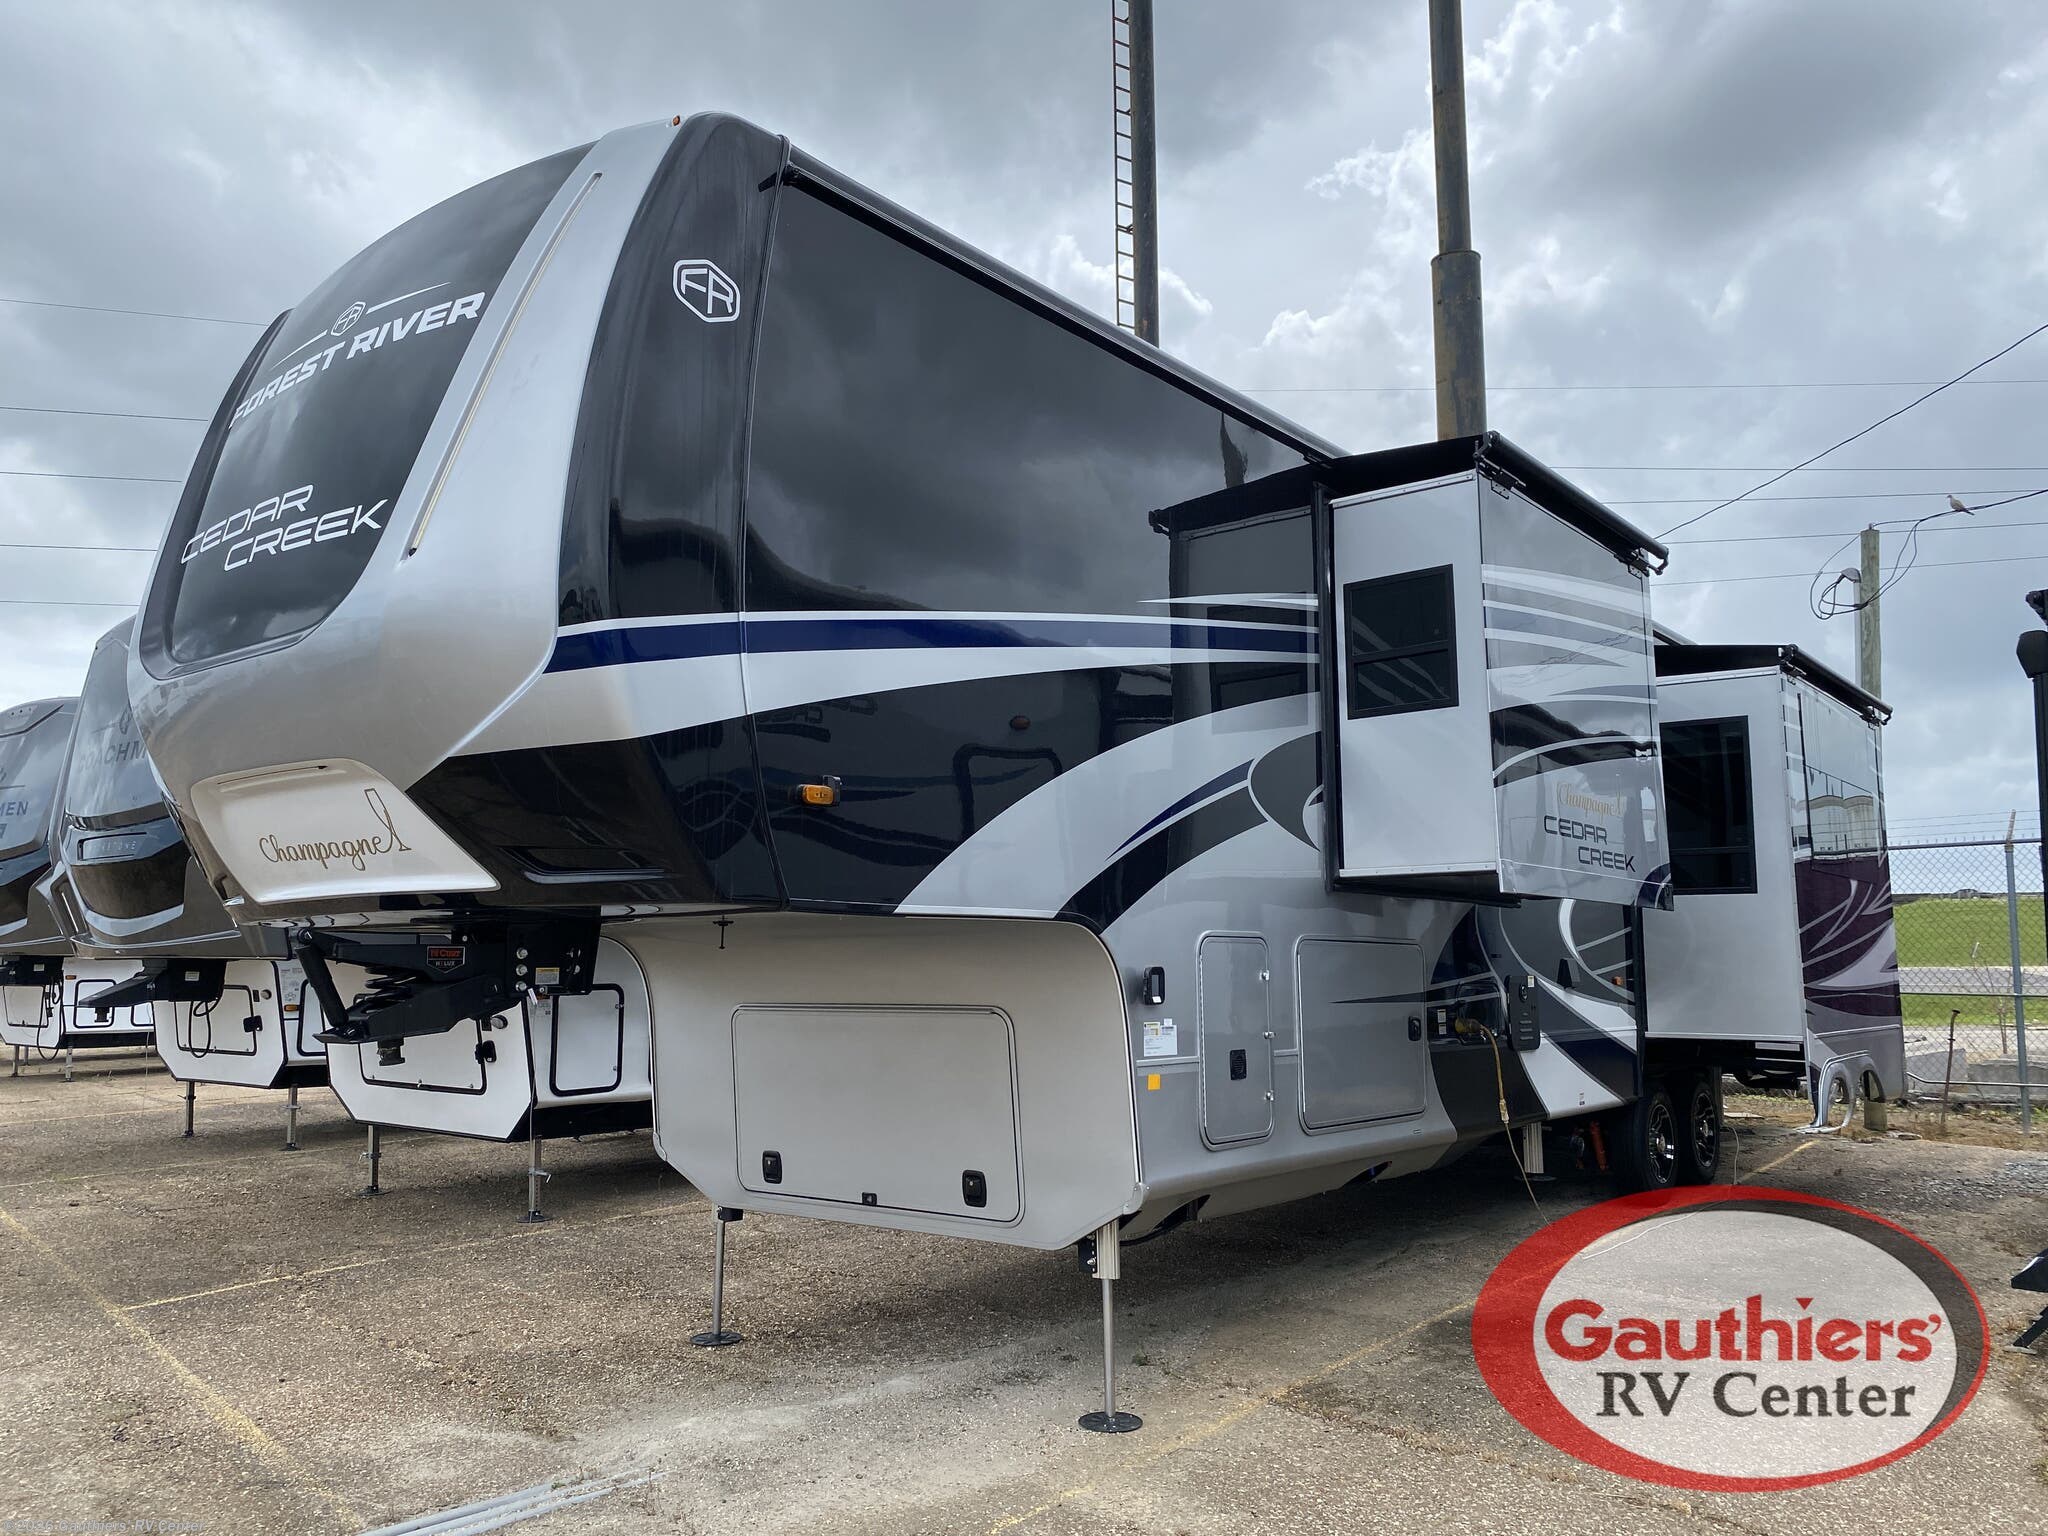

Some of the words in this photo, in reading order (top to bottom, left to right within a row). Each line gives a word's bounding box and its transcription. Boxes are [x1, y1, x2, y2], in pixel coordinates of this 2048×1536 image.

[229, 341, 346, 429] FOREST
[347, 292, 486, 359] RIVER
[181, 484, 314, 564] CEDAR
[224, 498, 389, 571] CREEK
[80, 740, 147, 771] COACHM
[259, 812, 396, 871] Champagne
[1544, 815, 1608, 845] CEDAR
[1578, 846, 1636, 872] CREEK
